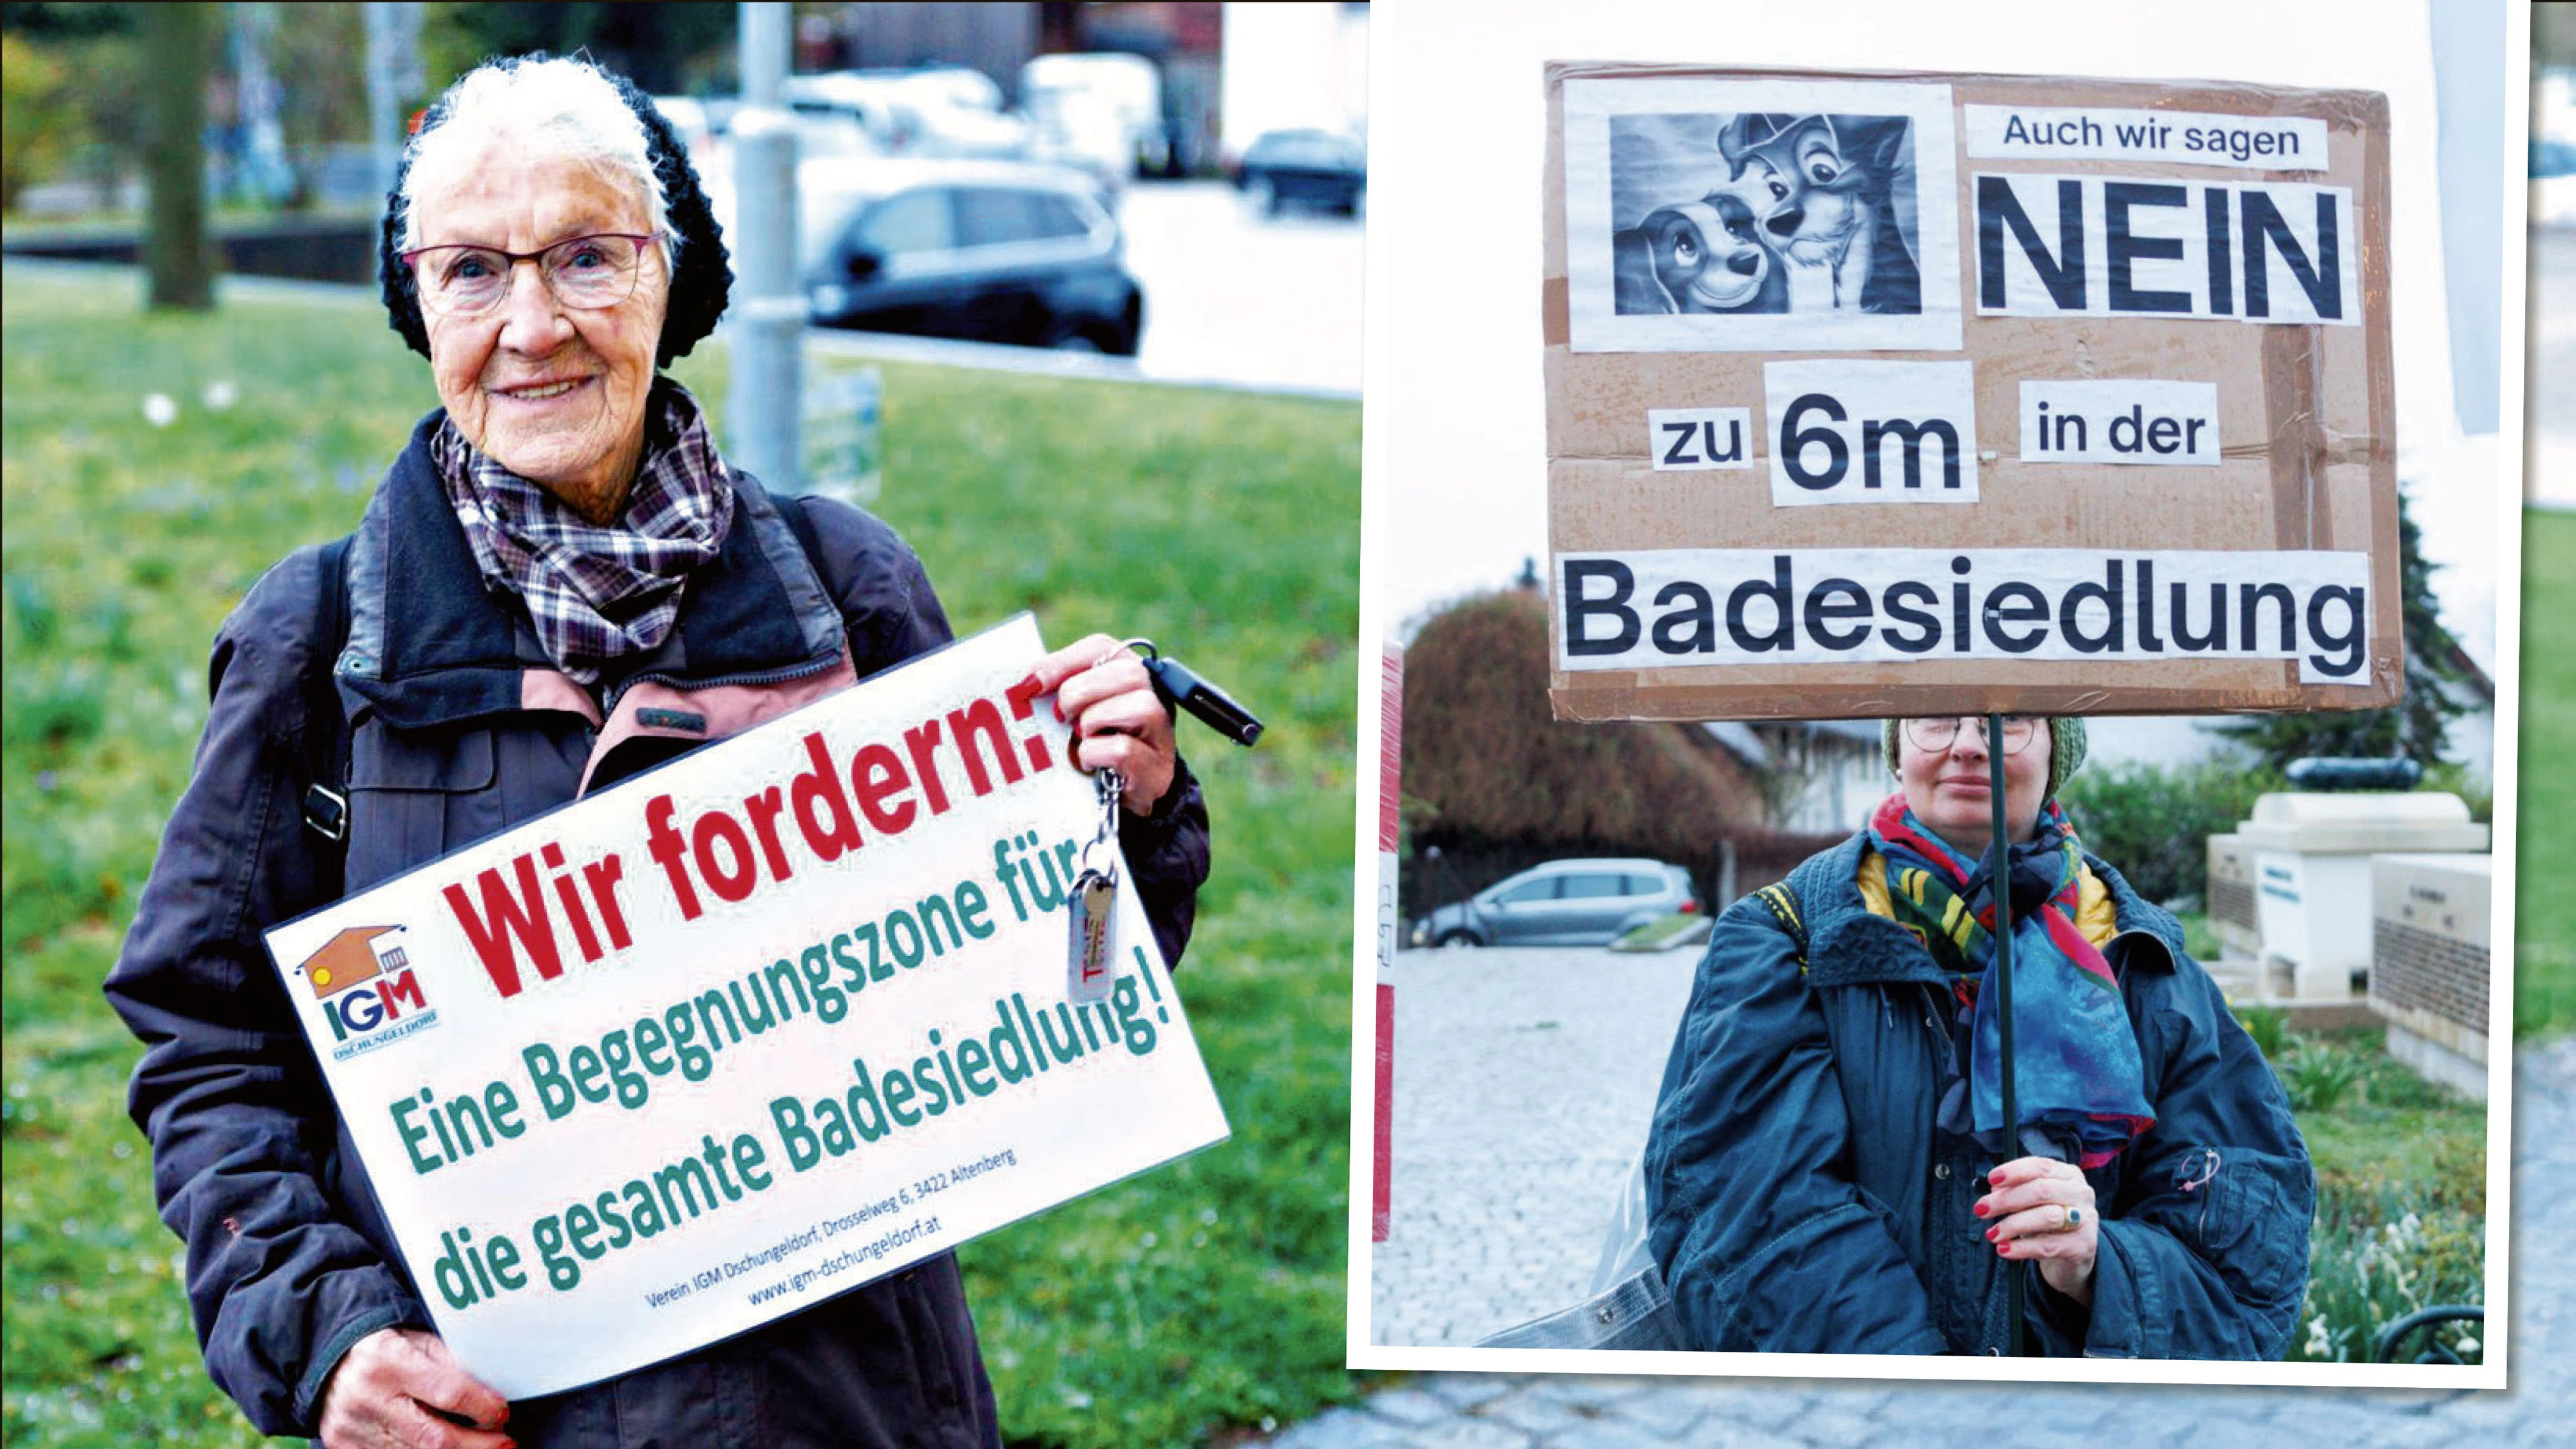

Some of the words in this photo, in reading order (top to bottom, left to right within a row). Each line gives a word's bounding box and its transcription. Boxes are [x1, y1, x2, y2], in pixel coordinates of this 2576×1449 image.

[2003, 115, 2103, 147] Auch
[2116, 118, 2172, 148] wir
[2184, 128, 2300, 161] sagen
[1978, 176, 2343, 320] NEIN
[1662, 417, 1745, 465] zu
[1778, 393, 1962, 491] 6m
[2037, 402, 2087, 452] in
[2109, 404, 2207, 455] der
[1563, 555, 2365, 678] Badesiedlung
[442, 842, 632, 998] Wir
[323, 967, 427, 1041] IGM
[390, 1081, 526, 1174] Eine
[522, 878, 996, 1120] Begegnungszone
[994, 830, 1077, 922] für
[434, 1226, 527, 1311] die
[532, 1130, 773, 1292] gesamte
[769, 945, 1170, 1173] Badesiedlung!
[645, 1278, 691, 1309] Verein
[692, 1267, 723, 1291] IGM
[724, 1227, 822, 1279] Dschungeldorf,
[822, 1197, 900, 1238] Drosselweg
[899, 1188, 915, 1206] 6,
[914, 1173, 949, 1200] 3422
[950, 1148, 1019, 1185] Altenberg
[747, 1214, 942, 1307] www.igm-dschungeldorf.at
